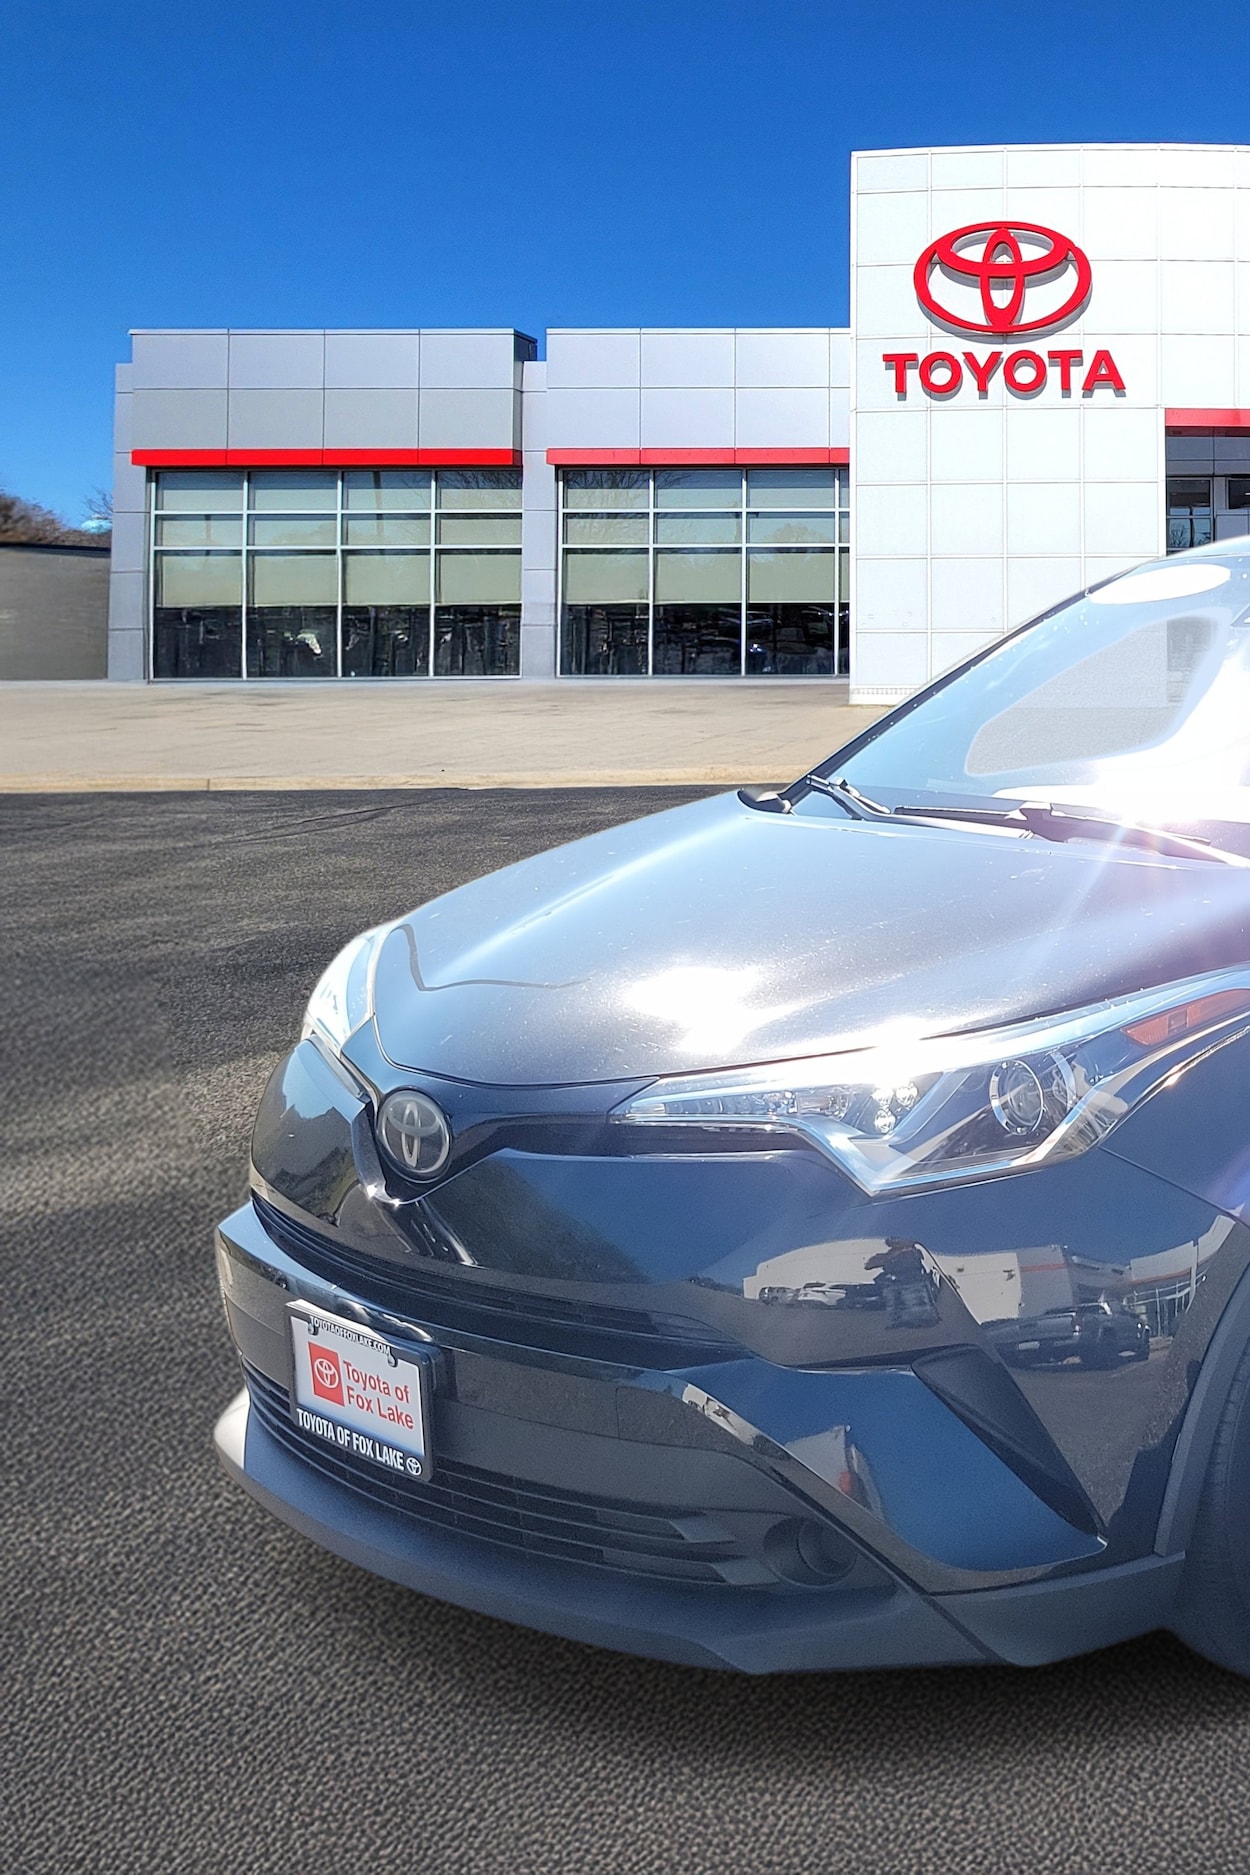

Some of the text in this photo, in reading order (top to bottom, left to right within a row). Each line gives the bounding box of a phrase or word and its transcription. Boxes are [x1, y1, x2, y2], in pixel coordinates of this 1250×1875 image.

[882, 349, 1127, 395] TOYOTA
[343, 1360, 410, 1404] Toyota of
[346, 1385, 414, 1430] Fox Lake
[296, 1408, 405, 1471] TOYOTA OF FOX LAKE
